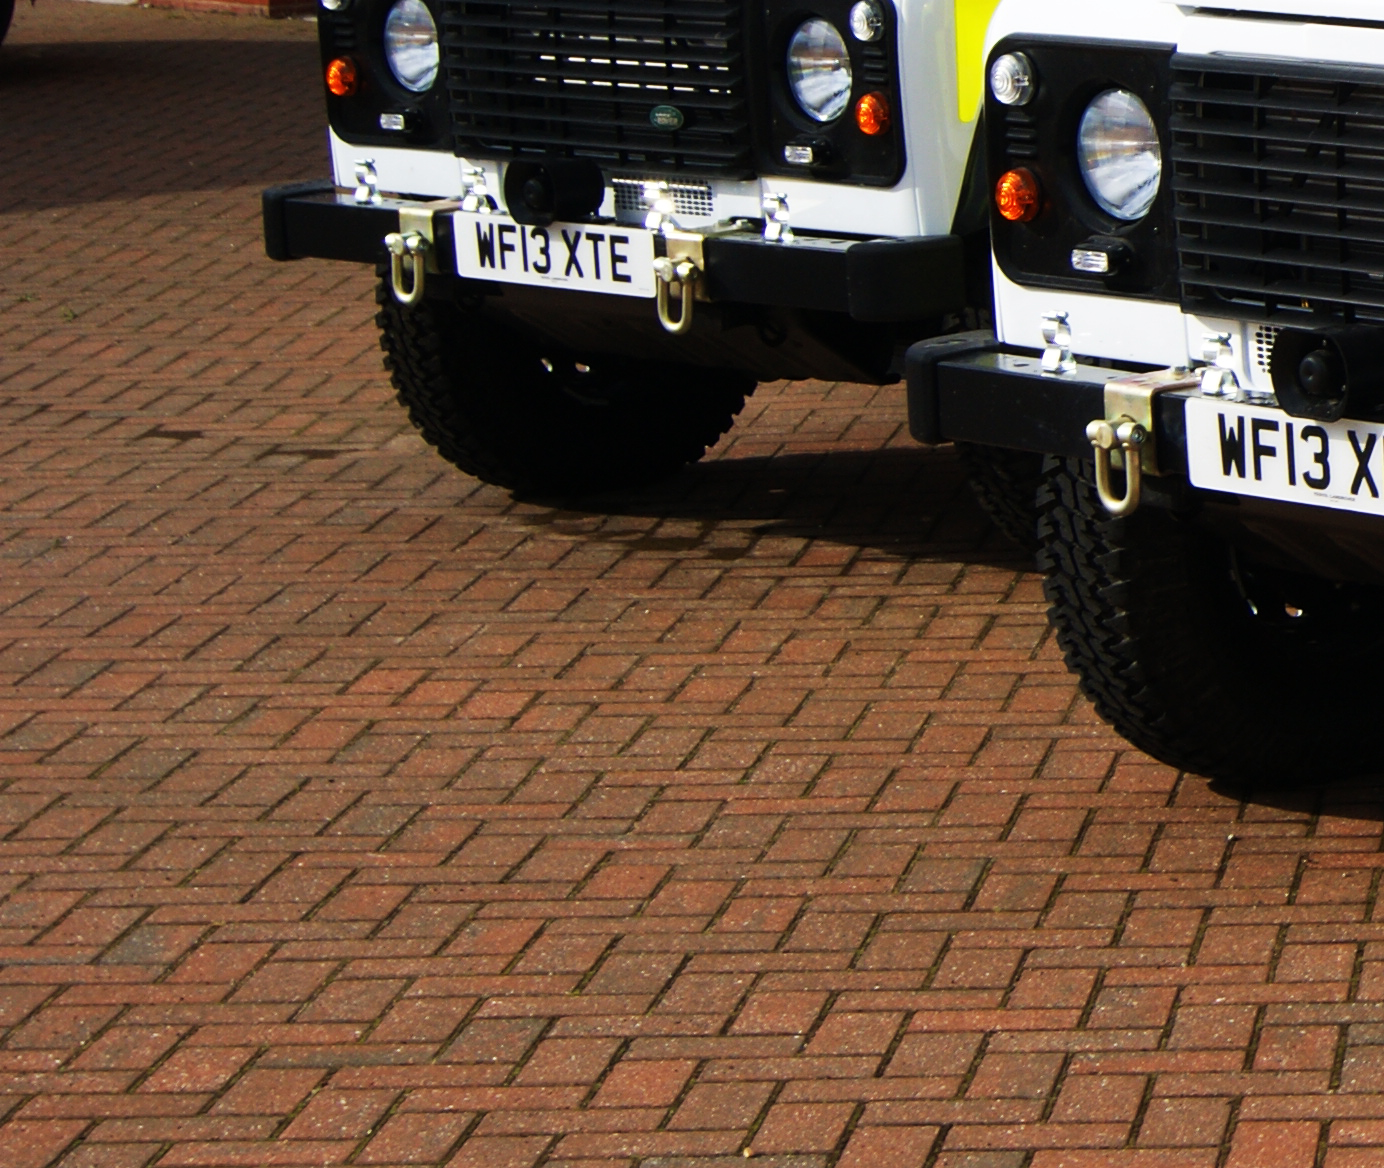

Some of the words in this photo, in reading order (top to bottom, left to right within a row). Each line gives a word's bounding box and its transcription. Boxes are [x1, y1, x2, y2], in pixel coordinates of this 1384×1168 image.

[475, 221, 551, 274] WF13
[561, 229, 633, 283] XTE
[1217, 413, 1331, 490] WF13
